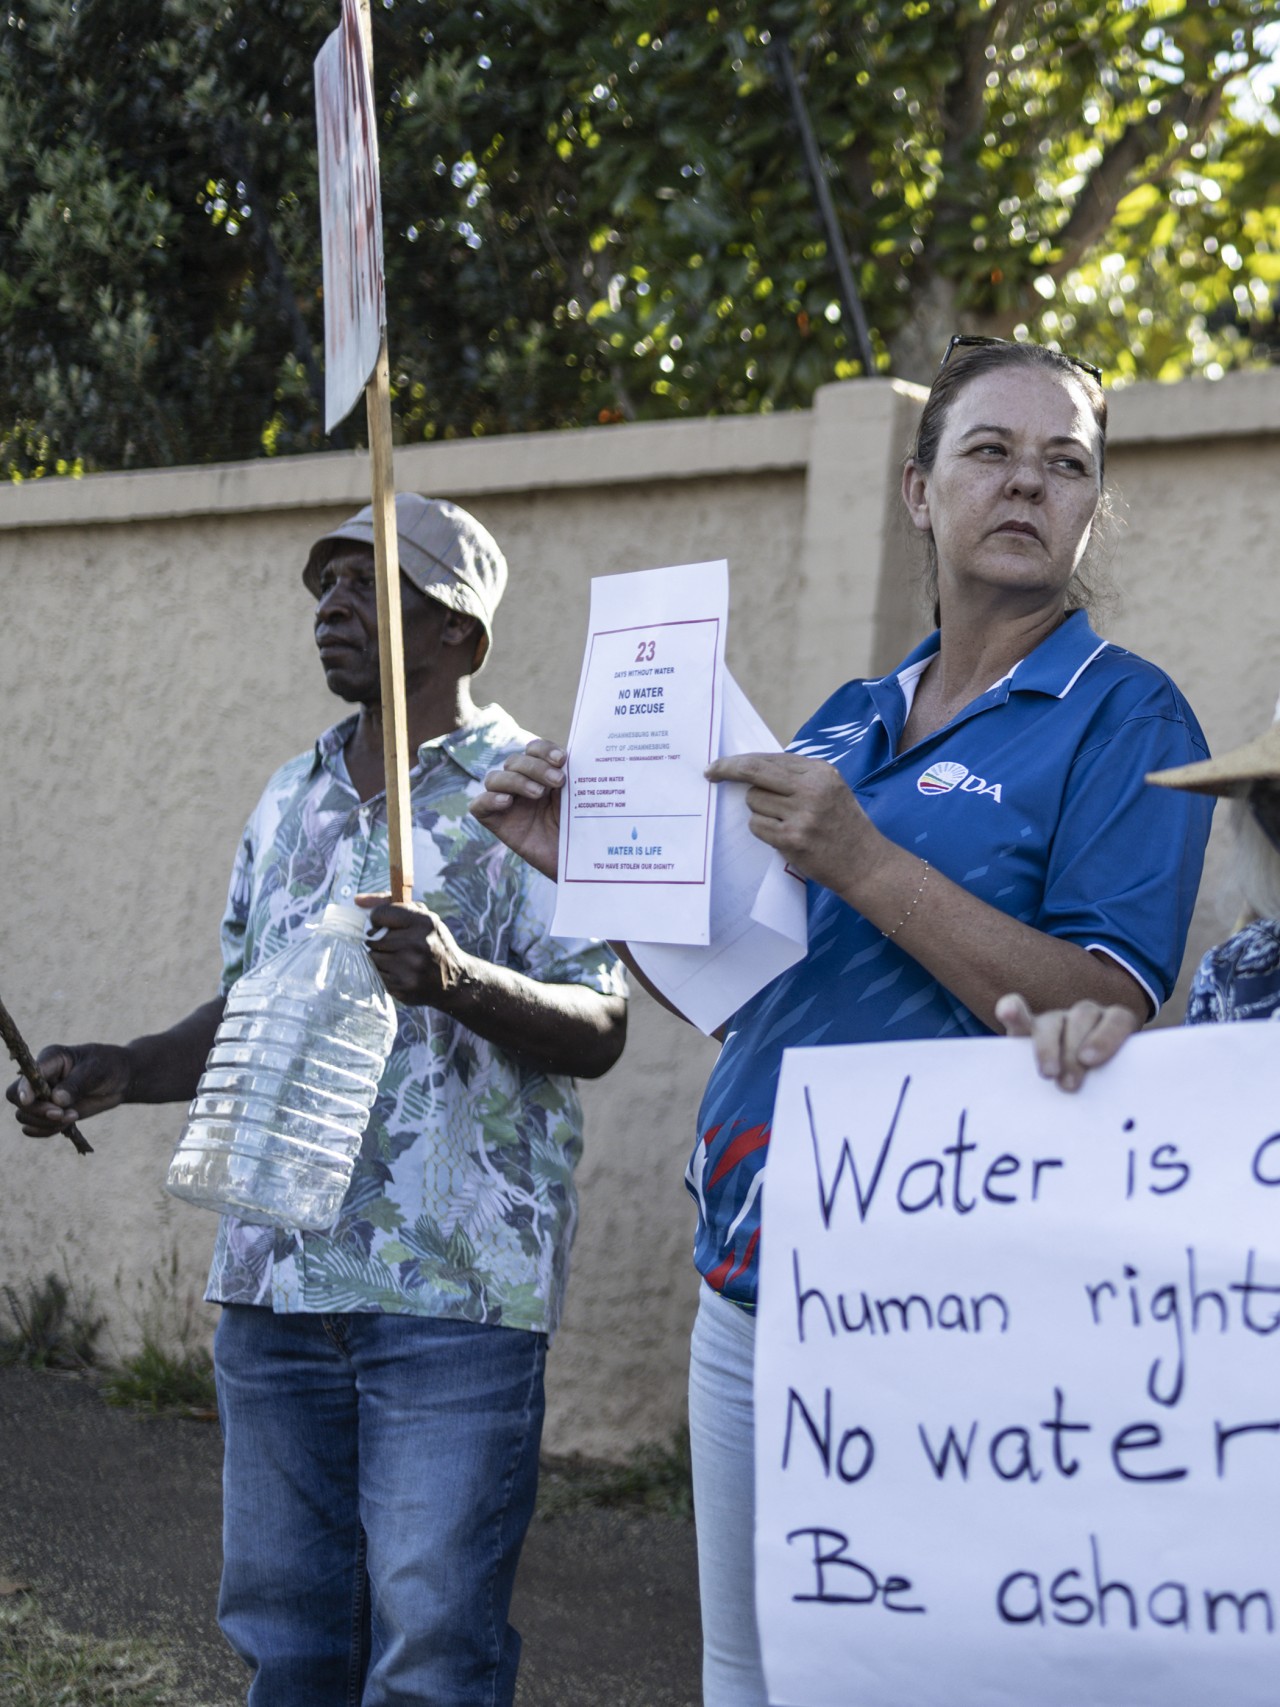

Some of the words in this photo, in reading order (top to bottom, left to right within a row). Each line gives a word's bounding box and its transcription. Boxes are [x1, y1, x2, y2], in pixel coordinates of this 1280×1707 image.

[635, 640, 656, 662] 23
[614, 671, 627, 679] DAYS
[628, 668, 653, 677] WITHOUT
[654, 666, 675, 675] WATER
[618, 689, 631, 699] NO
[633, 687, 664, 698] WATER
[614, 705, 627, 715] NO
[629, 703, 665, 715] EXCUSE
[607, 731, 649, 739] JOHANNESBURG
[627, 743, 670, 751] JOHANNESBURG
[959, 774, 1003, 803] DA
[607, 846, 633, 855] WATER
[635, 846, 643, 855] IS
[645, 846, 662, 855] LIFE
[804, 1075, 1063, 1230] Water
[1122, 1117, 1190, 1199] is
[793, 1247, 1009, 1343] human
[781, 1385, 874, 1484] No
[786, 1526, 926, 1615] Be
